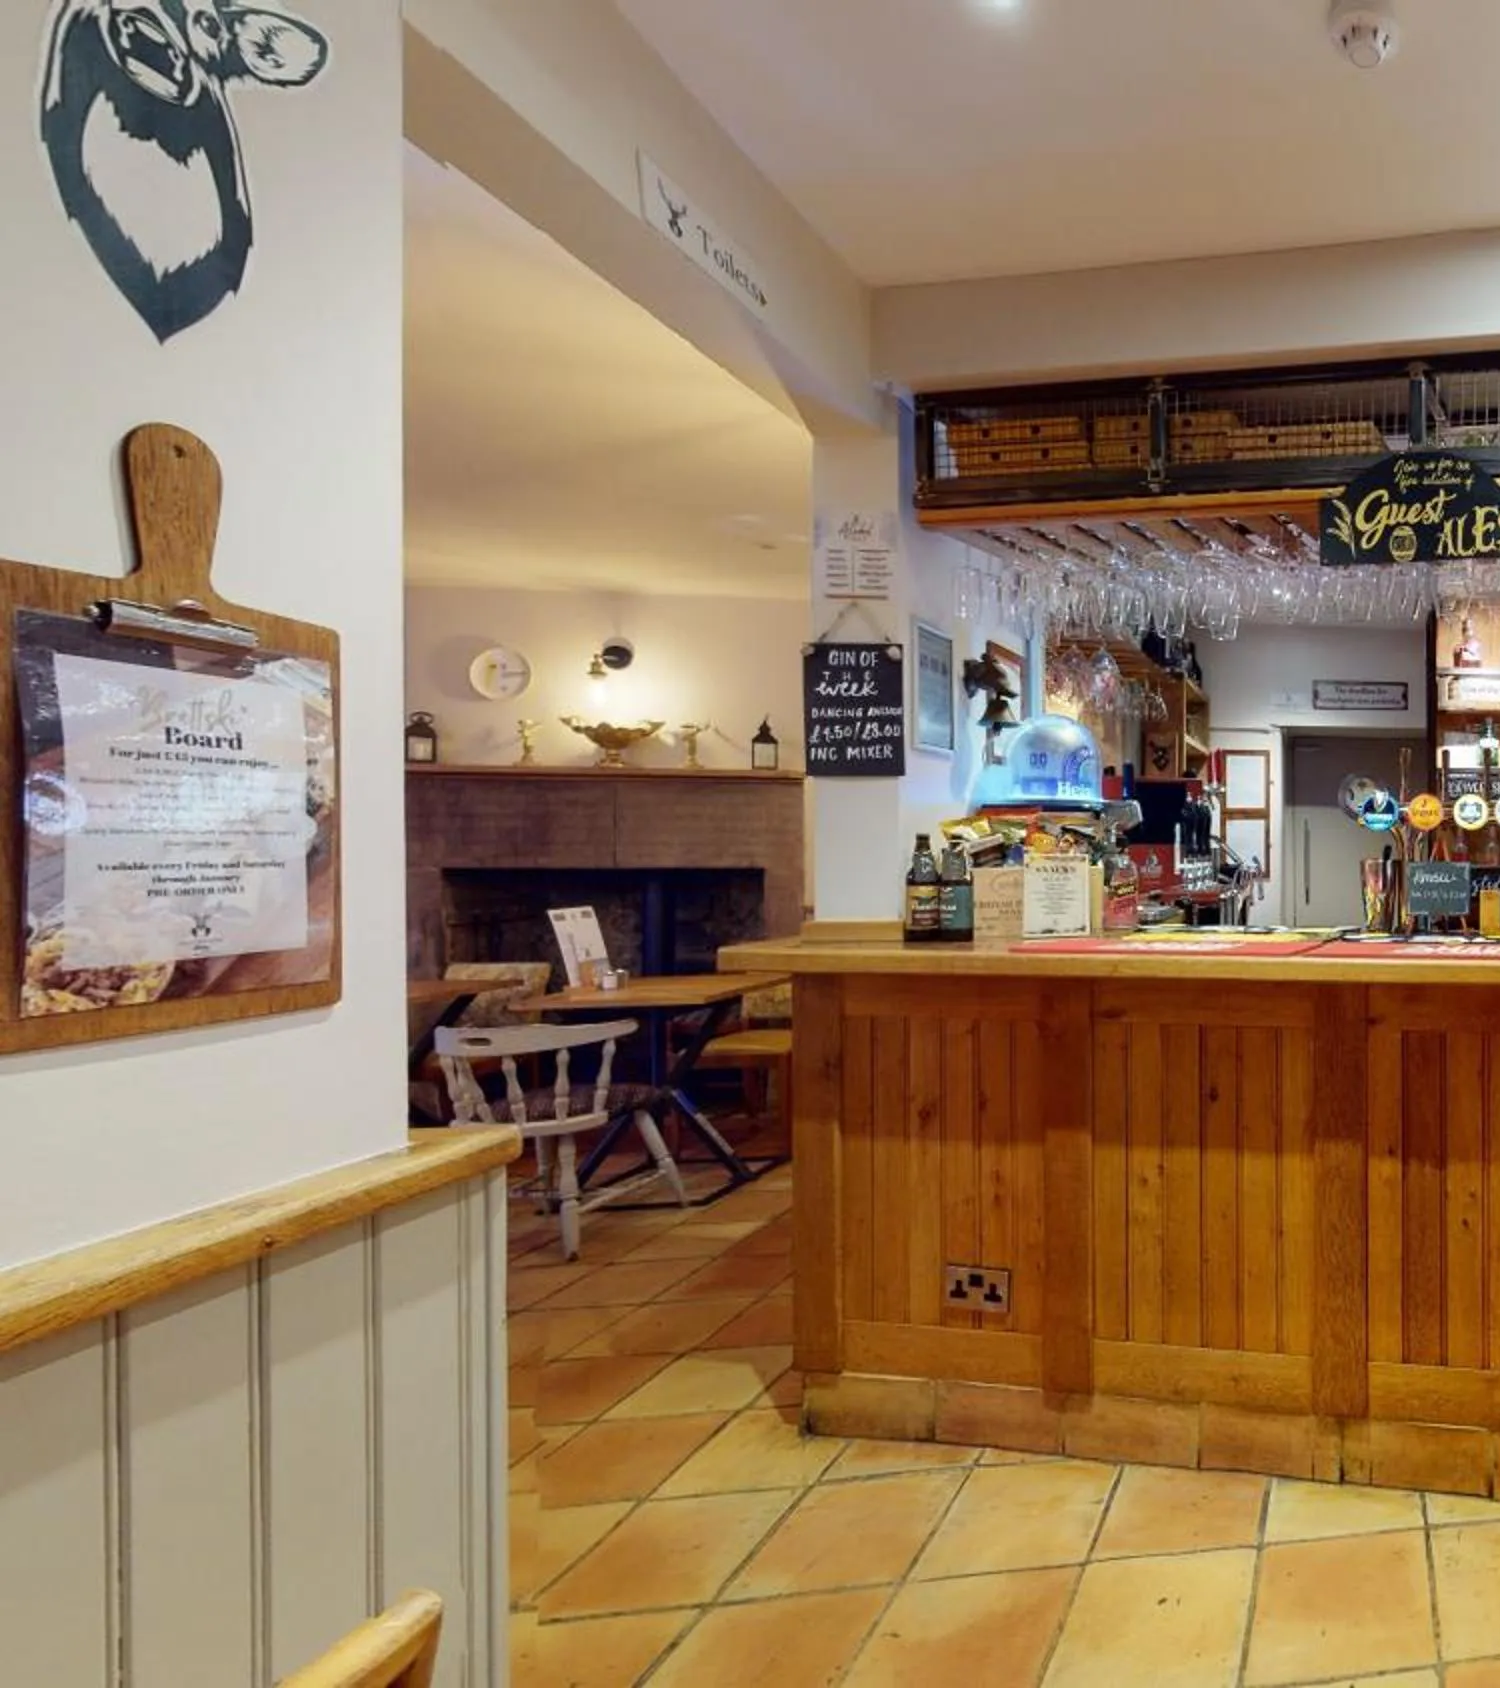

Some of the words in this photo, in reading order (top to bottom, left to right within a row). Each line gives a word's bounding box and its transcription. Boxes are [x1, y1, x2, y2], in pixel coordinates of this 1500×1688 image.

[695, 223, 767, 308] Toilets
[1355, 488, 1457, 550] Guest
[828, 650, 856, 667] GIN
[860, 651, 879, 667] OF
[815, 681, 879, 697] week
[164, 726, 243, 751] Board
[810, 747, 838, 761] INC
[846, 744, 893, 760] MIXER
